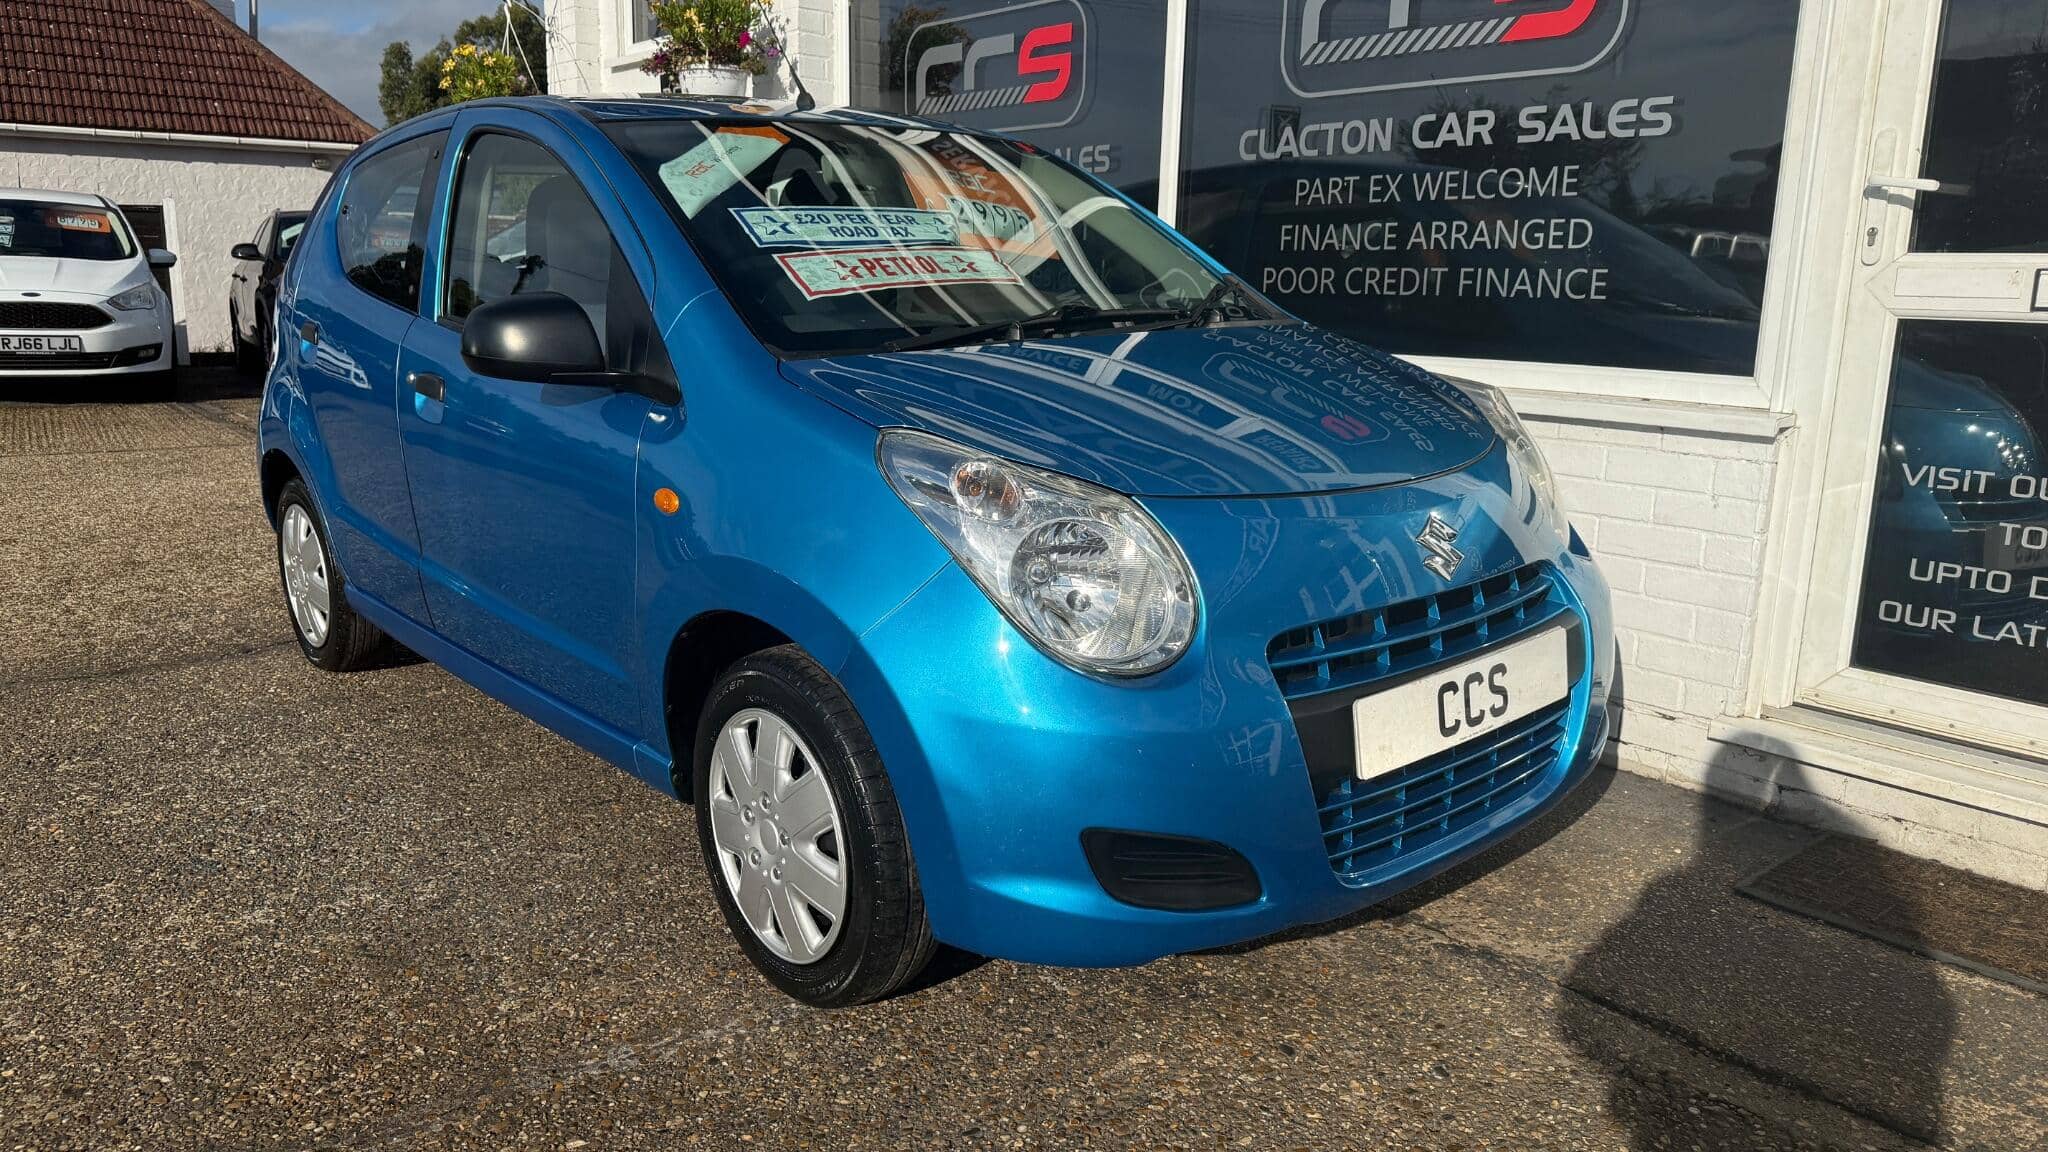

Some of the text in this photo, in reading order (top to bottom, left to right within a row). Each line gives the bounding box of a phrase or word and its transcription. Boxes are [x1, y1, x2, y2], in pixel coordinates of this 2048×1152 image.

[1239, 96, 1674, 160] CLACTON CAR SALES
[1295, 165, 1579, 206] PART EX WELCOME
[794, 212, 919, 226] £20 PER YEAR
[828, 226, 916, 238] ROAD TAX
[1280, 218, 1593, 252] FINANCE ARRANGED
[857, 254, 951, 278] PETROL
[1262, 266, 1609, 300] POOR CREDIT FINANCE
[1, 337, 78, 350] RJ66 LJL
[1902, 463, 1995, 494] VISIT
[1909, 558, 2012, 594] UPTO
[1878, 600, 1957, 634] OUR
[1437, 663, 1508, 738] CCS
